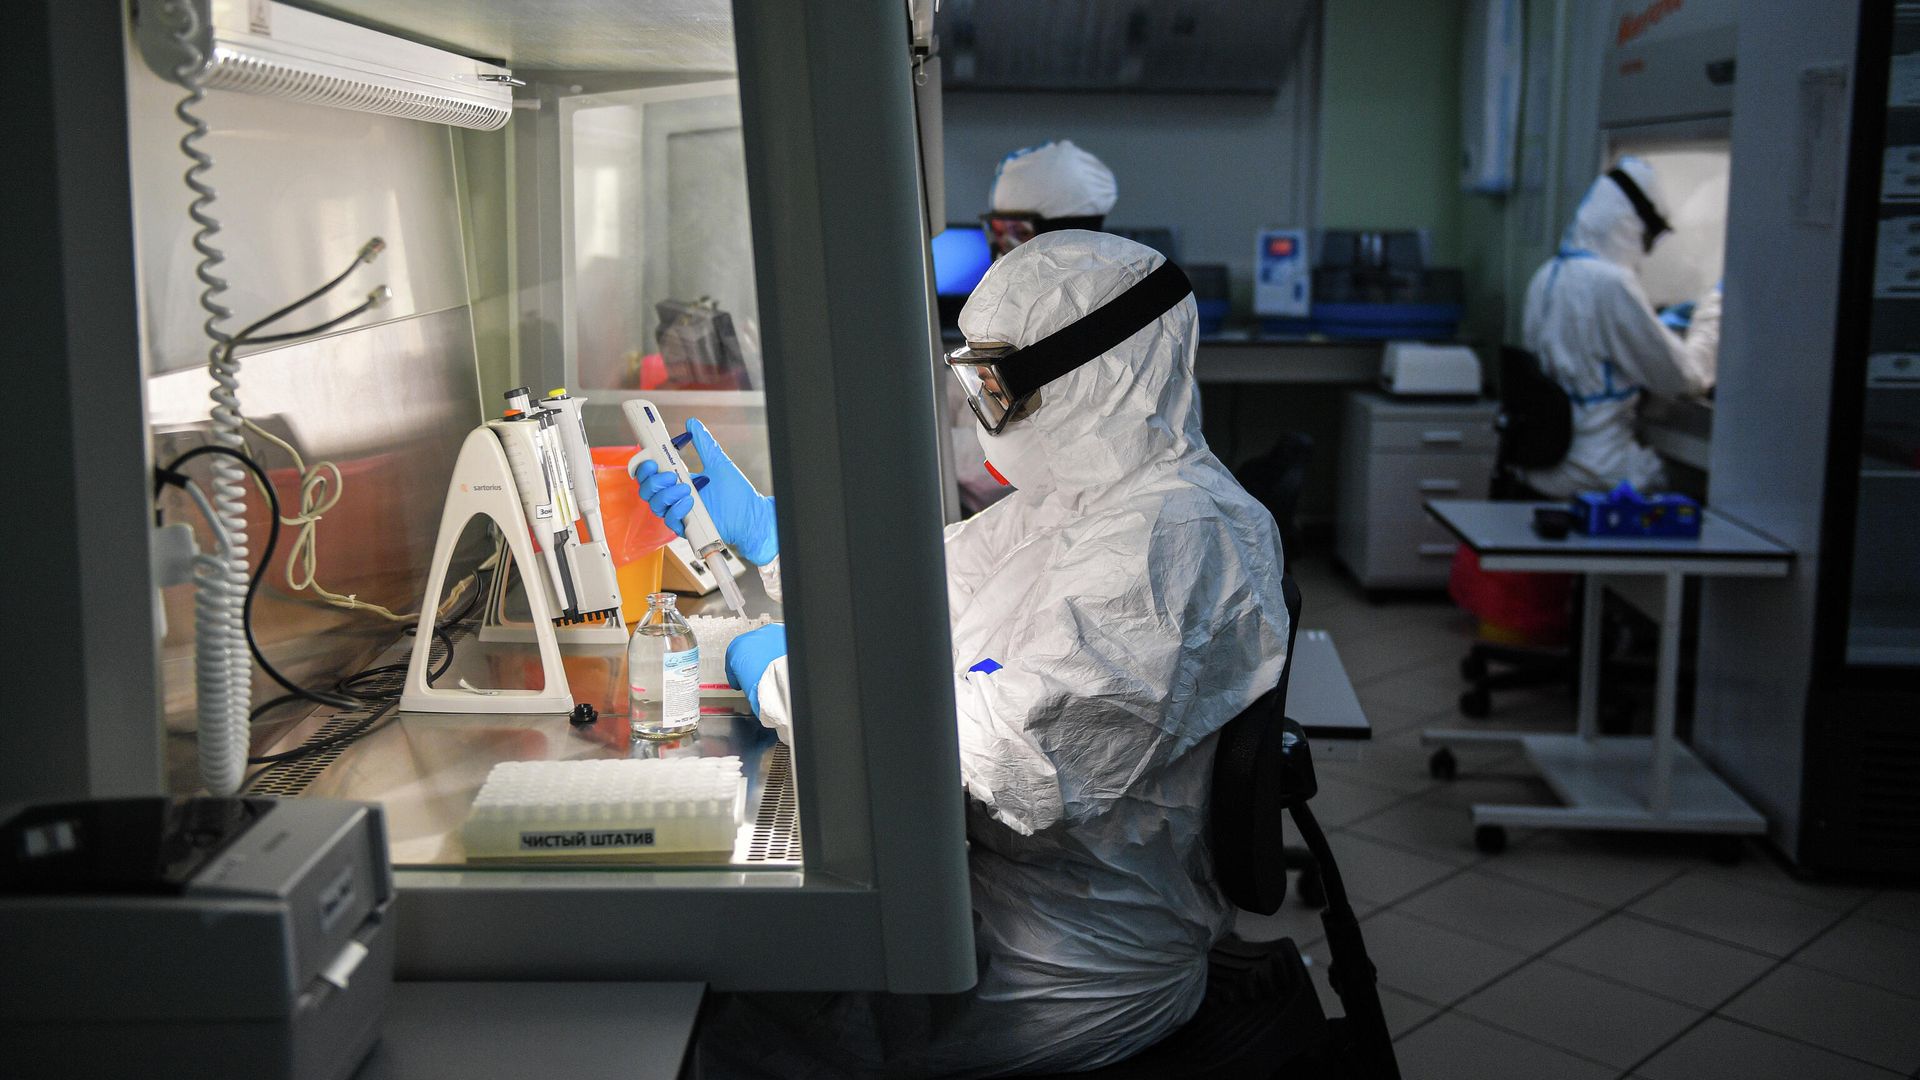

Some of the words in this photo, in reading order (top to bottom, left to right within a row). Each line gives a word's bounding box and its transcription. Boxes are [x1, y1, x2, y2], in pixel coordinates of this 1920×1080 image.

[473, 483, 502, 491] sartorius
[522, 831, 586, 847] ЧИСТЫЙ
[591, 832, 654, 846] ШТАТИВ
